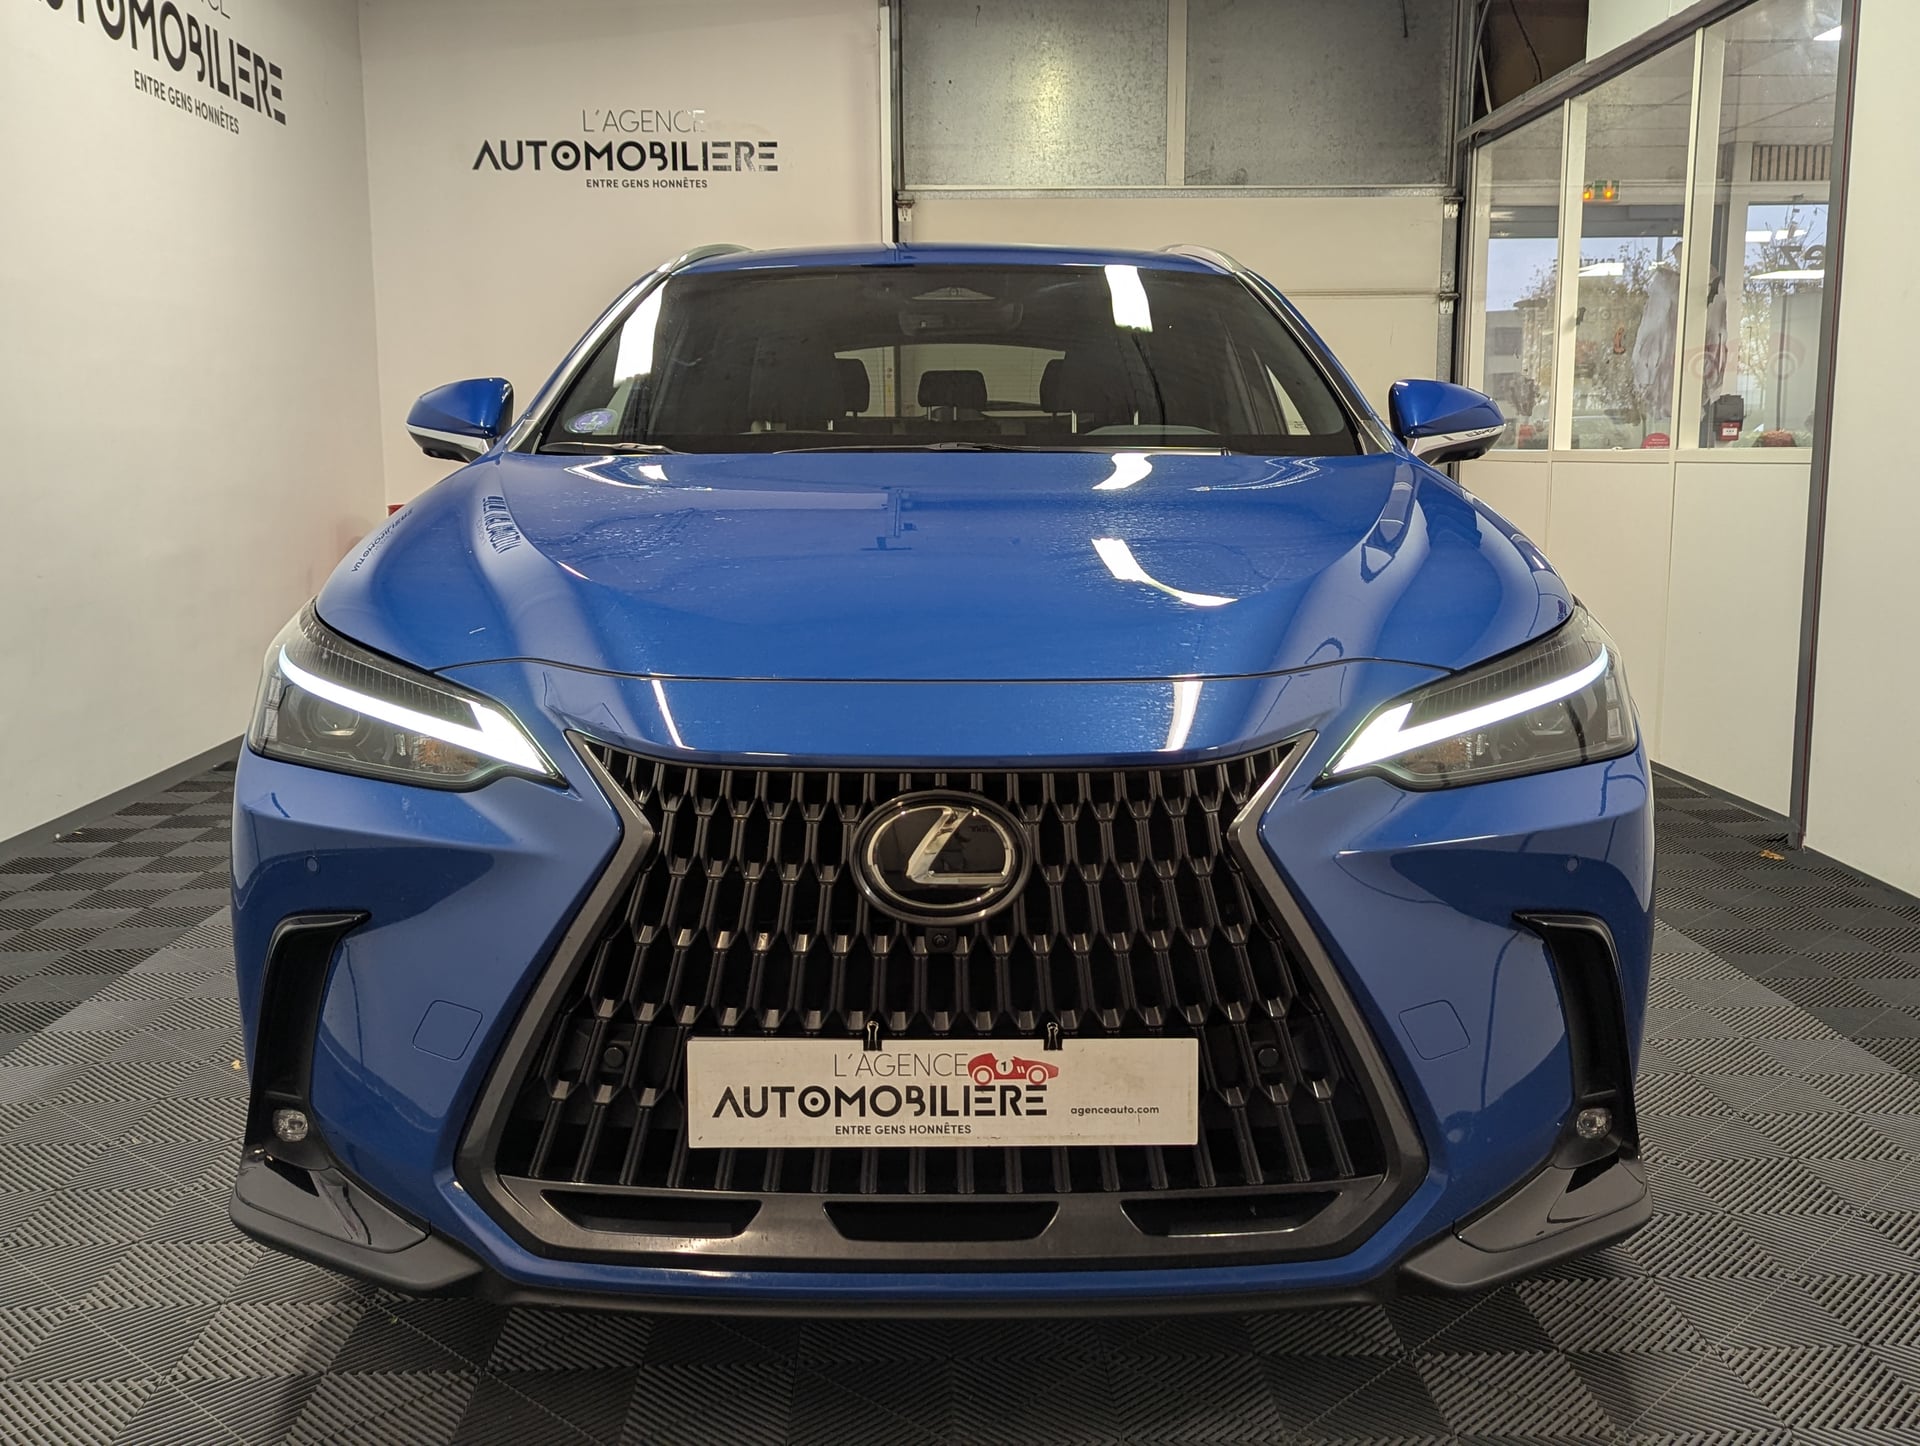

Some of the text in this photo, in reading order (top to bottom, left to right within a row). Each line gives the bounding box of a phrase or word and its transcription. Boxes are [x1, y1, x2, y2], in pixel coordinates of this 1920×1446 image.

[134, 70, 240, 135] ENTRE GENS HONNÊTES
[472, 140, 779, 172] AUTOMOBILIERE
[586, 176, 708, 189] ENTRE GENS HONNÊTES
[834, 1053, 968, 1077] L'AGENCE
[1000, 1061, 1007, 1072] 1
[711, 1084, 1048, 1119] AUTOMOBILIERE
[1070, 1105, 1160, 1117] agenceauto.com
[835, 1122, 972, 1135] ENTRE GENS HONNÊTES
